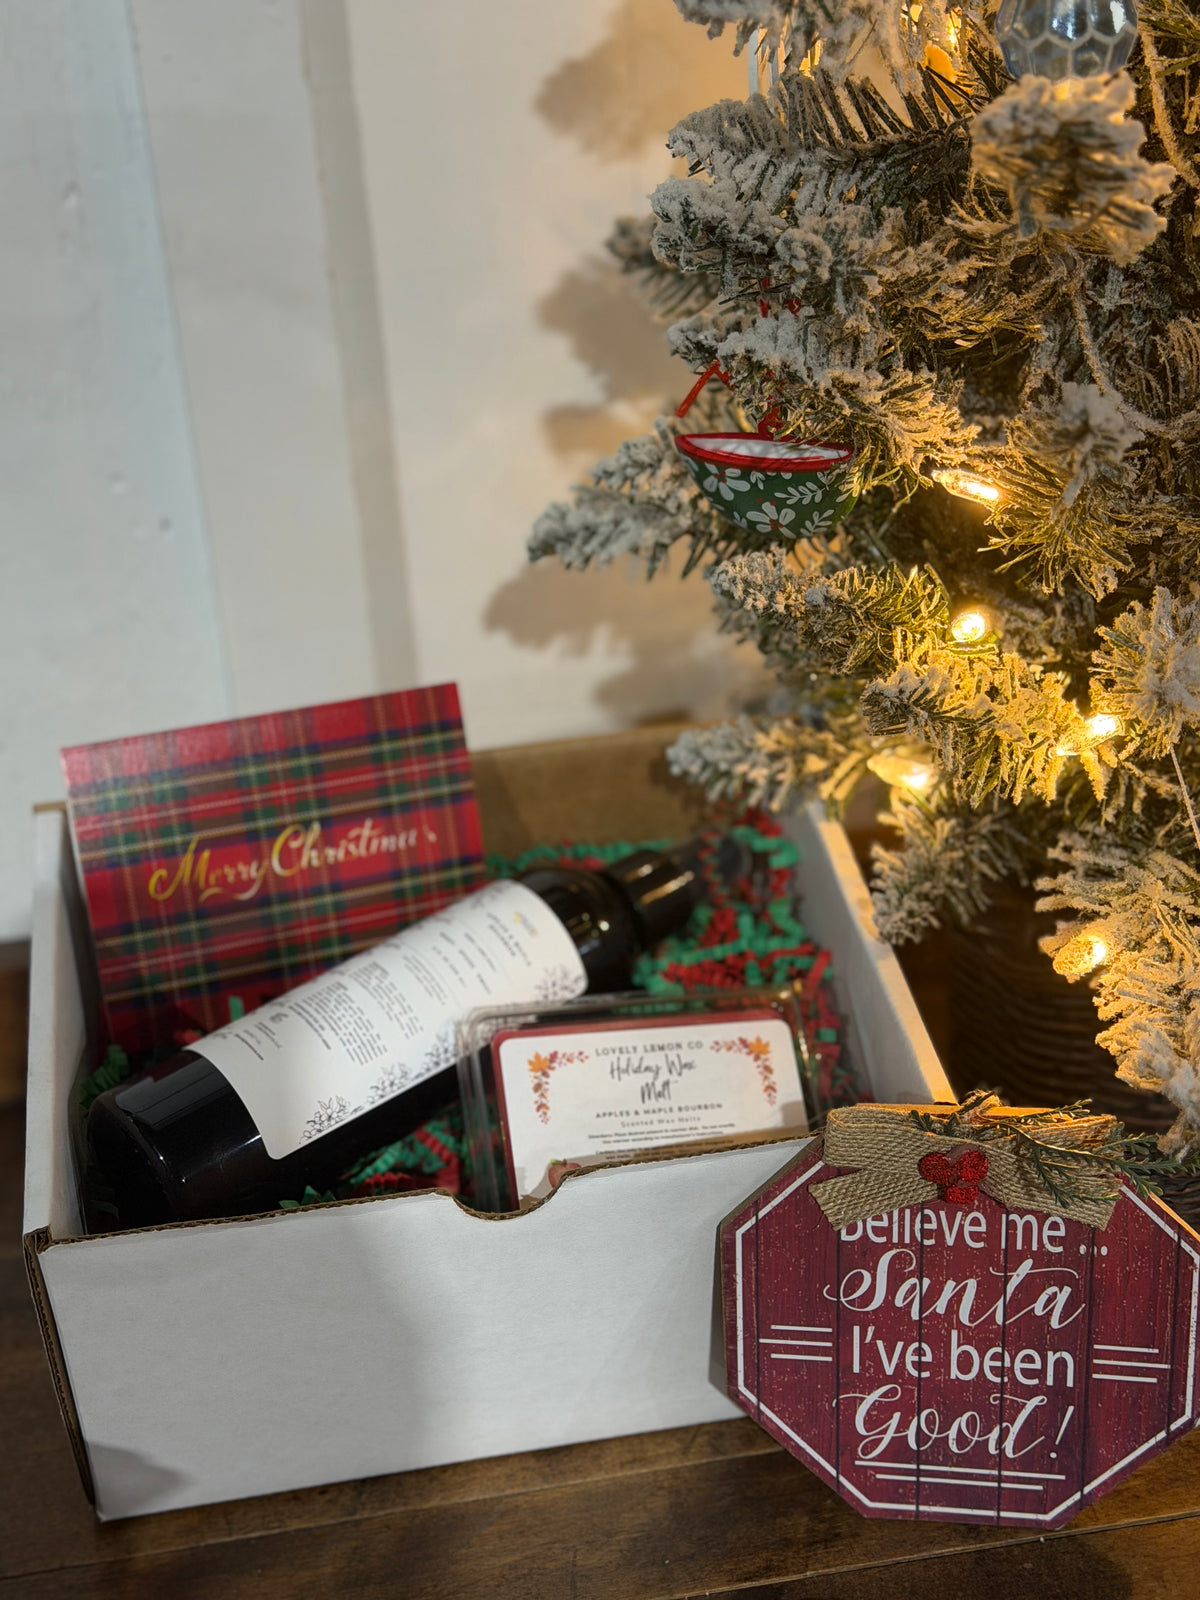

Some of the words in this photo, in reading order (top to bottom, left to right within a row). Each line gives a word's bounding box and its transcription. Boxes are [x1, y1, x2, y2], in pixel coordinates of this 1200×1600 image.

[148, 836, 267, 903] Merry
[271, 817, 437, 877] Christmas
[595, 1045, 638, 1057] LOVELY
[643, 1042, 683, 1053] LEMON
[687, 1040, 703, 1050] CO
[610, 1056, 661, 1082] Holiday
[665, 1053, 696, 1077] Wax
[596, 1109, 630, 1118] APPLES
[644, 1106, 674, 1115] MAPLE
[678, 1103, 723, 1112] BOURBON
[823, 1248, 1086, 1329] Santa
[853, 1325, 932, 1378] I've
[950, 1329, 1075, 1388] been
[832, 1384, 1075, 1459] Good!
